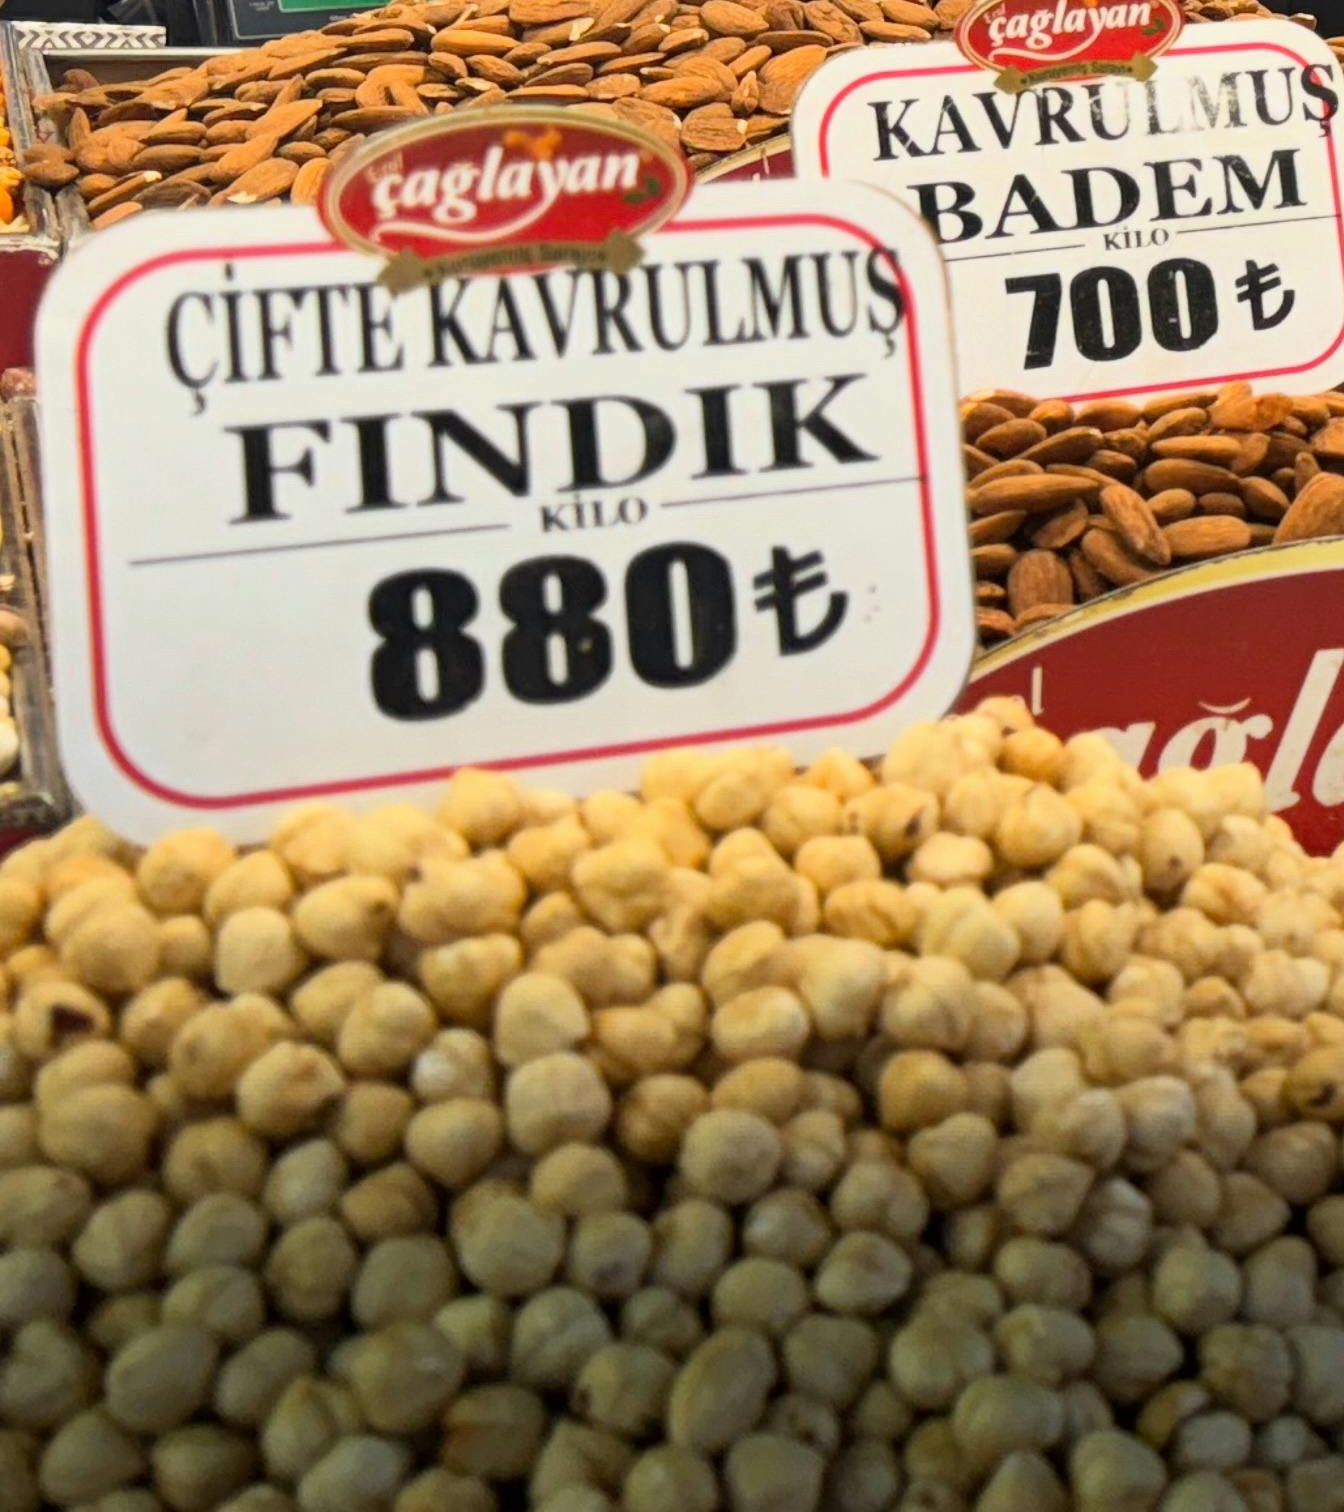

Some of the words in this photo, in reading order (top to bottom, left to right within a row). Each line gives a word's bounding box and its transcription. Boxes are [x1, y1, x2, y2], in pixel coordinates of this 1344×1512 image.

[868, 64, 1340, 161] KAVRULMUŞ
[908, 149, 1309, 245] BADEM
[1101, 224, 1171, 253] KİLO
[165, 272, 405, 415] ÇİFTE
[428, 247, 907, 371] KAVRULMUŞ
[224, 372, 882, 527] FINDIK
[539, 490, 651, 538] KİLO
